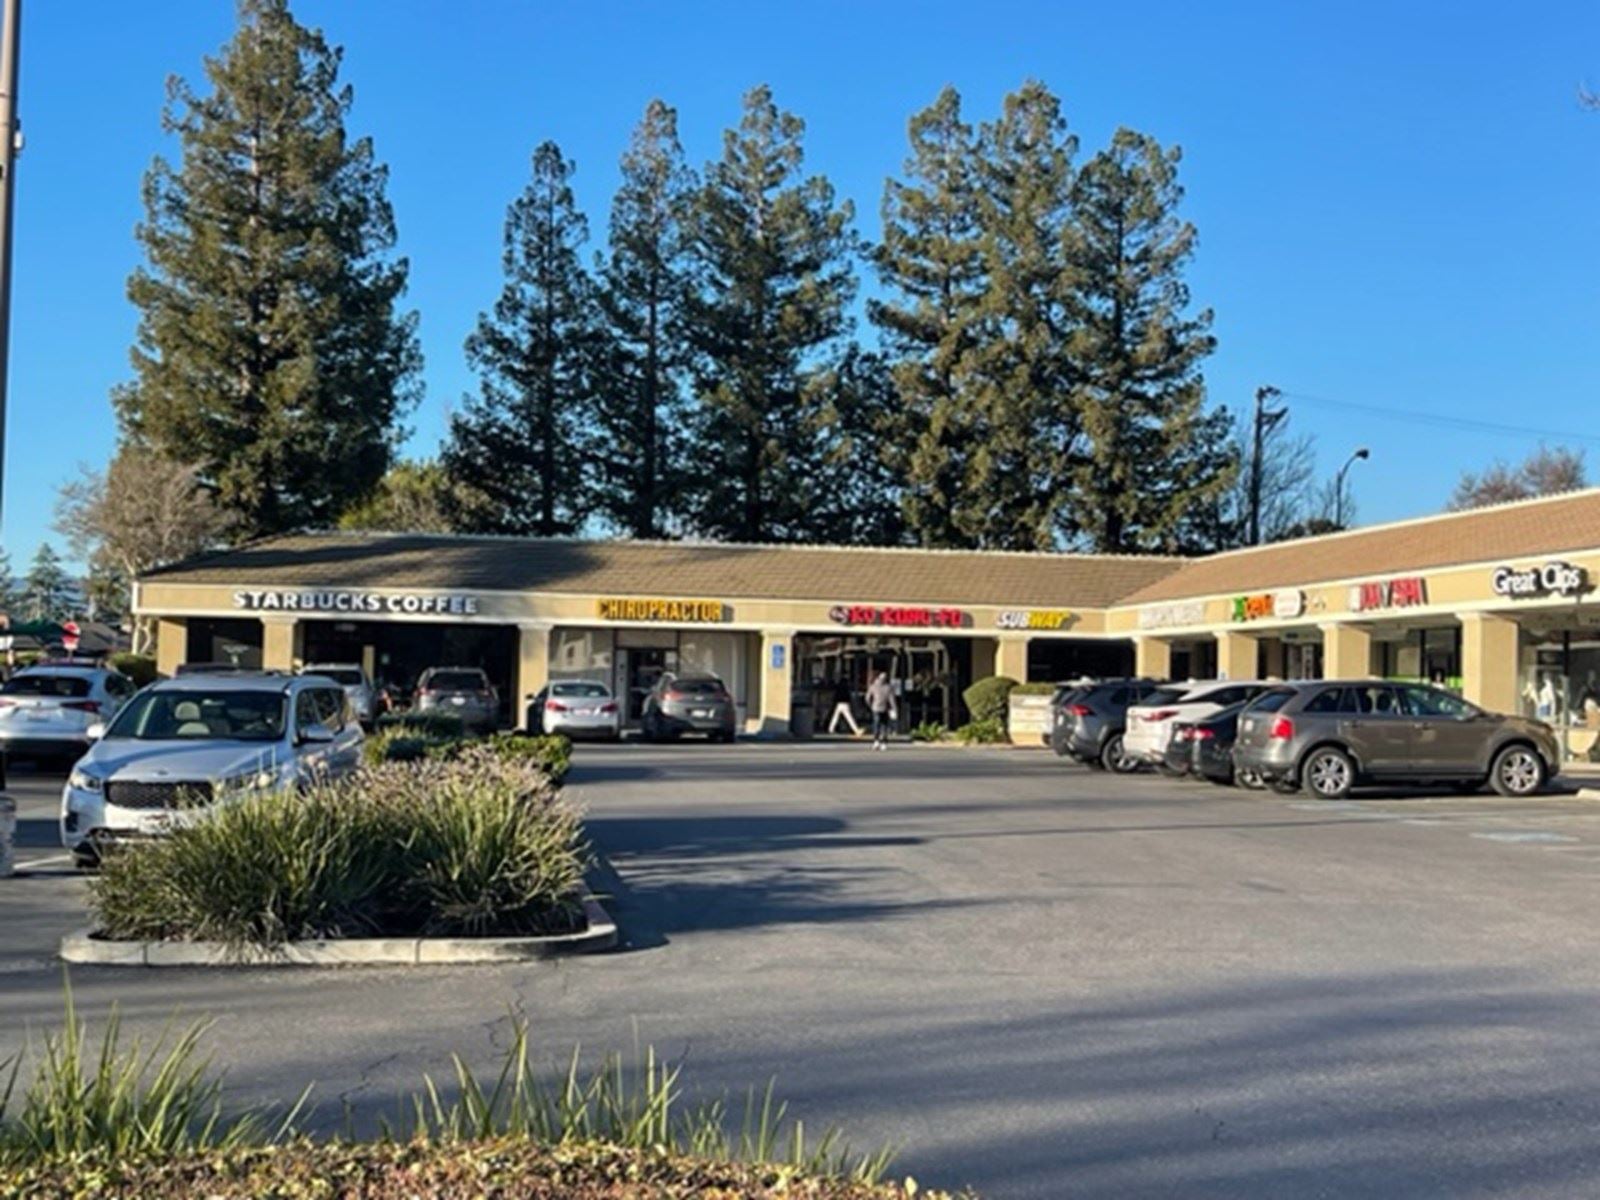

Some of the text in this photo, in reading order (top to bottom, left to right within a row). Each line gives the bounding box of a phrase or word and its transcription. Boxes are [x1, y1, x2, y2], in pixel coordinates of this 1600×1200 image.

[1493, 568, 1537, 594] Great
[233, 590, 478, 614] STARBUCKS COFFEE
[596, 599, 723, 622] CHIROPRACTOR
[995, 610, 1070, 629] SUBWAY
